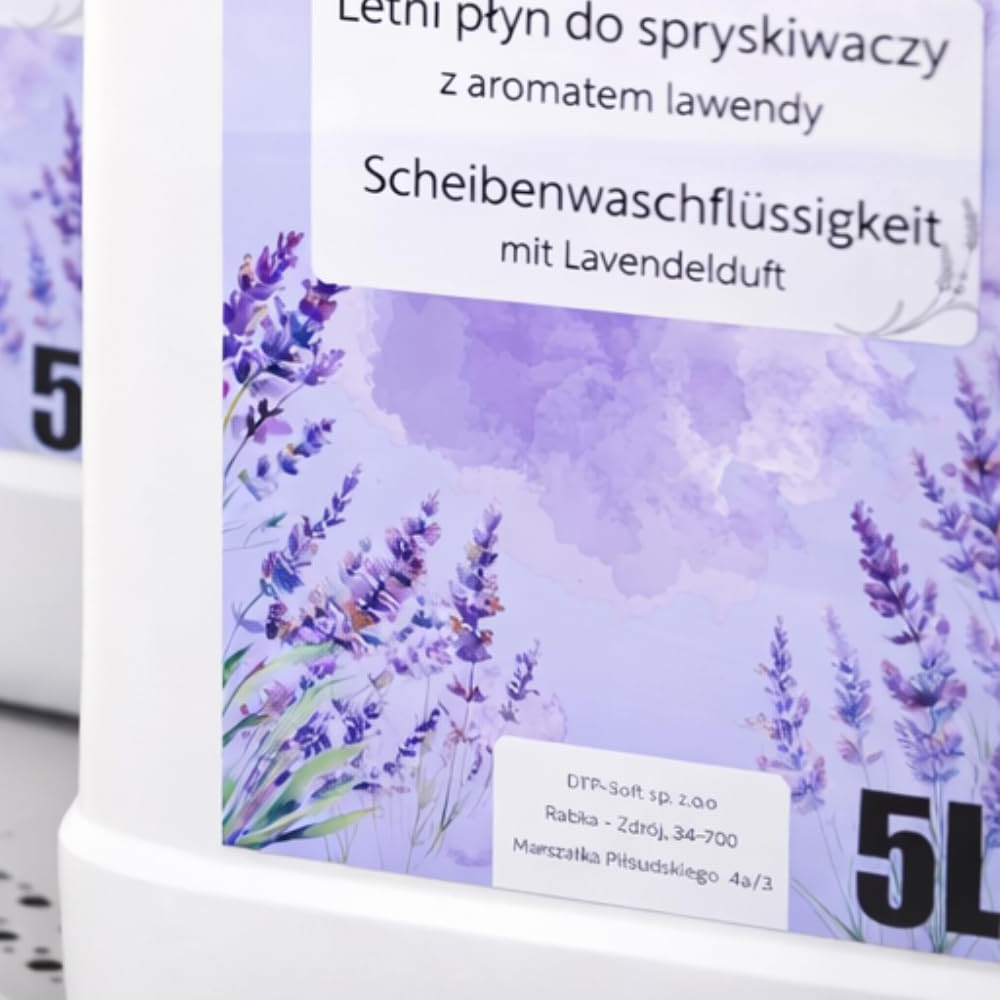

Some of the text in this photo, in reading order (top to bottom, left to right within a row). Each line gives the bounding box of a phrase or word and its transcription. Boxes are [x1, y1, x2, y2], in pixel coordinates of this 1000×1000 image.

[565, 0, 624, 43] do
[639, 13, 950, 81] spryskiwaczy
[439, 71, 824, 137] z aromatem lawendy
[363, 154, 943, 251] Scheibenwaschflüssigkeit
[501, 236, 787, 292] mit Lavendelduft
[544, 804, 600, 827] Rabka
[566, 772, 645, 801] DTP-Soft
[856, 788, 1000, 940] 5L
